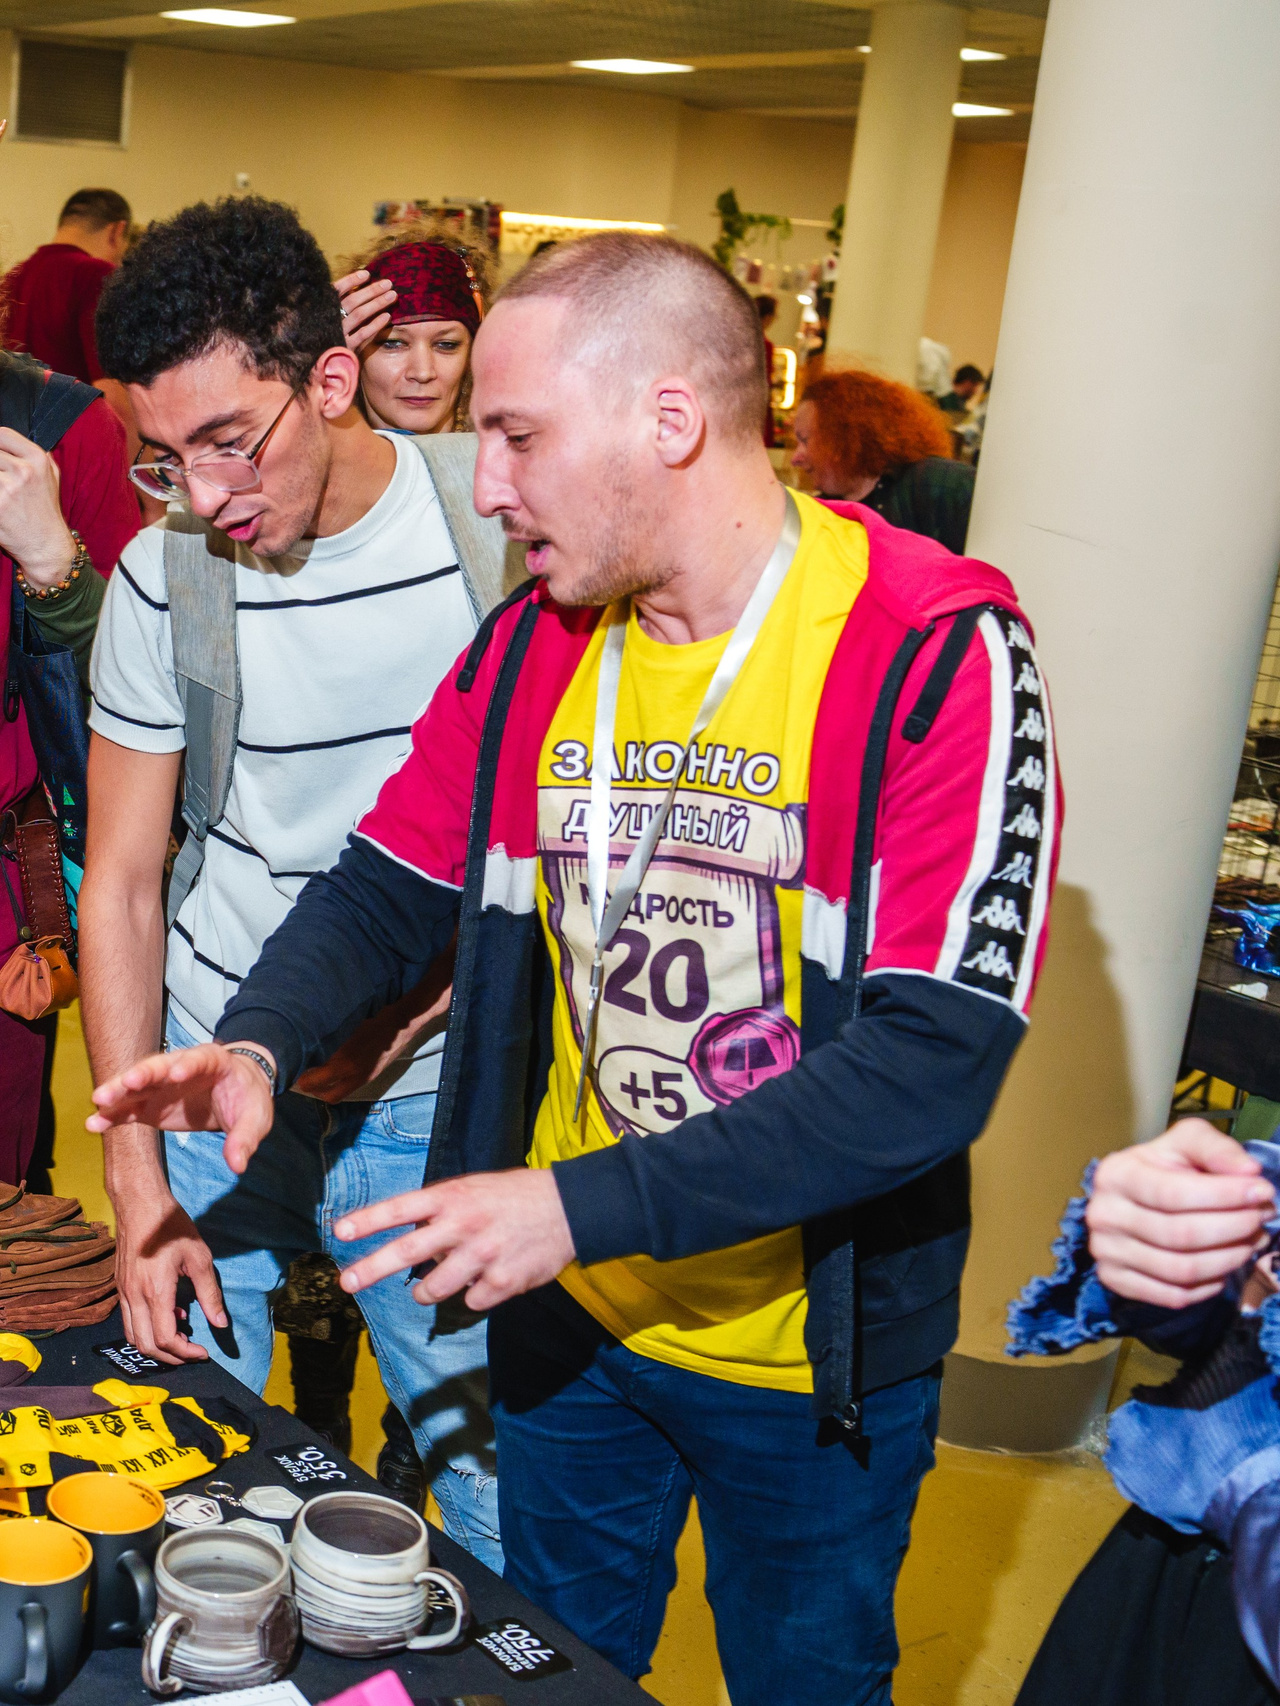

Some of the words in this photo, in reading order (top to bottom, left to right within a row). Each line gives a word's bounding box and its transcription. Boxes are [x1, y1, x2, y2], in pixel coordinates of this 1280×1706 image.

[578, 882, 735, 928] ДРОСТЬ
[596, 928, 710, 1023] 20
[620, 1070, 688, 1122] +5
[120, 1343, 159, 1367] 450
[273, 1455, 309, 1483] БРЕЛОК
[475, 1637, 523, 1672] БЛОКНОТ
